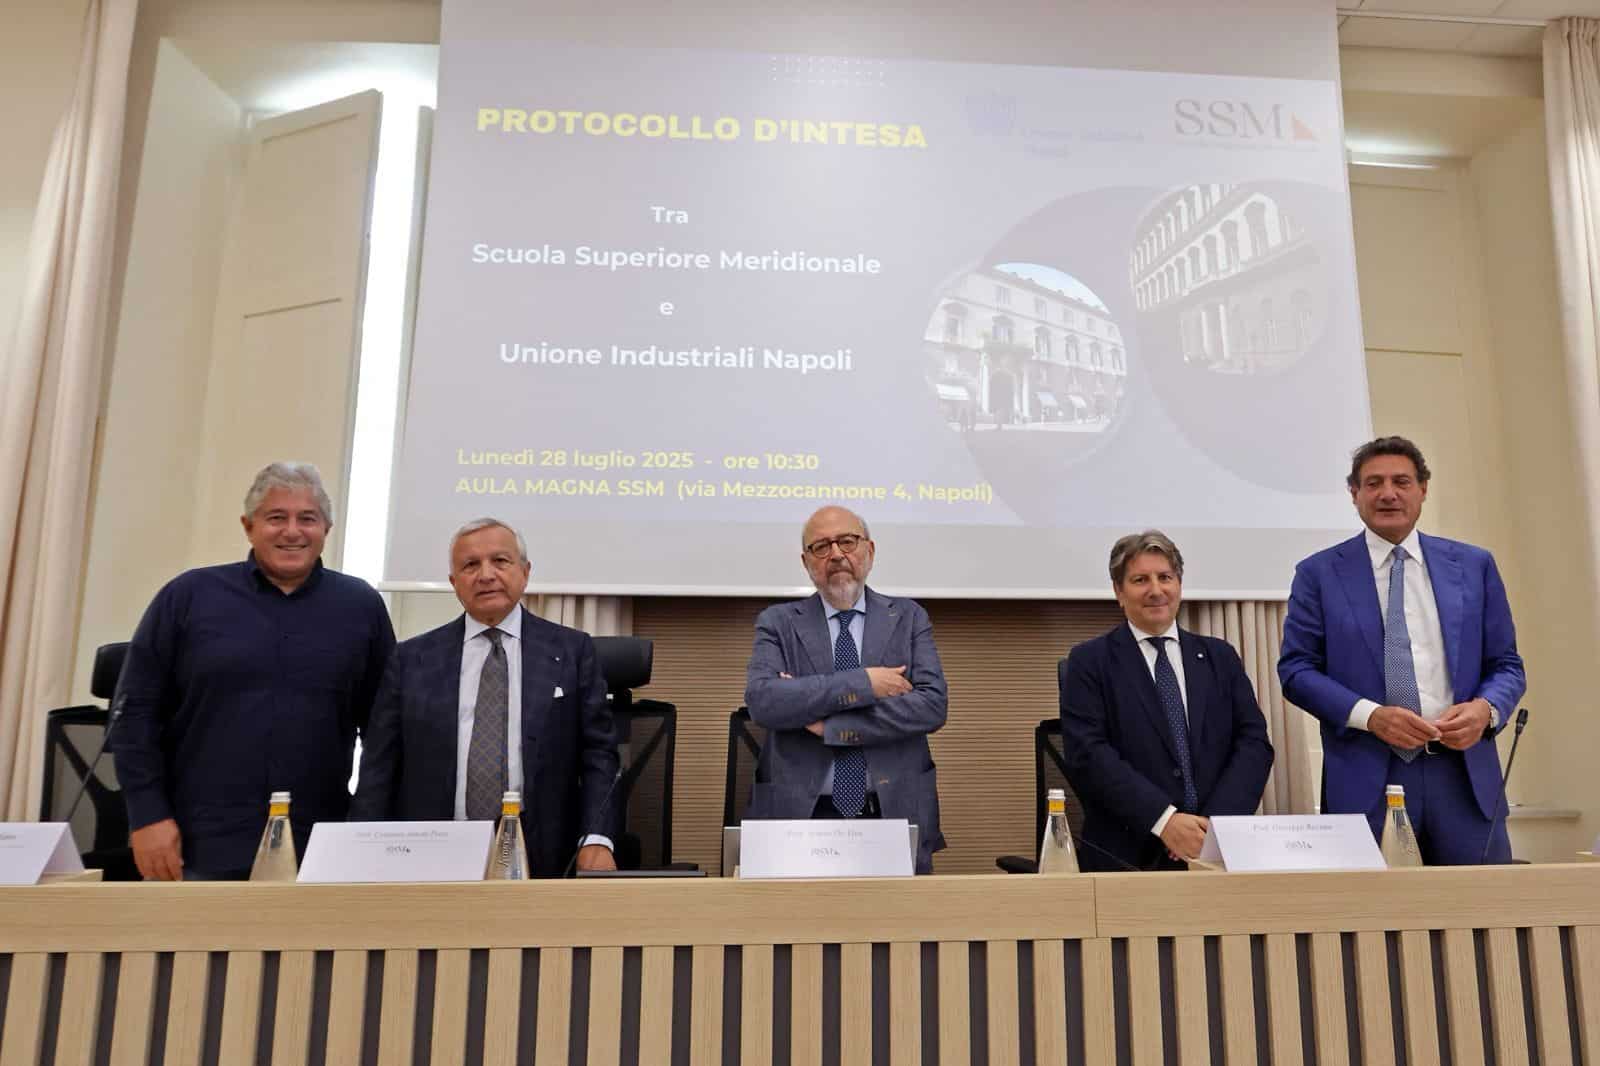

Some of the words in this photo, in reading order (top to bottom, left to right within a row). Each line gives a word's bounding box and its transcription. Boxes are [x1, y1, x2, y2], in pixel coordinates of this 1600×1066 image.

[476, 107, 741, 142] PROTOCOLLO
[753, 117, 929, 149] D'INTESA
[1174, 97, 1284, 138] SSM
[650, 206, 689, 225] Tra
[471, 243, 566, 266] Scuola
[575, 246, 712, 272] Superiore
[719, 250, 881, 274] Meridionale
[659, 301, 675, 316] e
[499, 342, 603, 365] Unione
[611, 344, 755, 369] Industriali
[763, 348, 853, 375] Napoli
[540, 450, 568, 467] 28
[573, 451, 636, 471] luglio
[641, 452, 695, 469] 2025
[723, 457, 761, 470] ore
[765, 453, 820, 471] 10:30
[455, 477, 518, 495] AULA
[525, 480, 611, 496] MAGNA
[617, 480, 665, 497] SSM
[677, 480, 715, 500] (via
[722, 481, 886, 500] Mezzocannone
[918, 483, 993, 506] Napoli)
